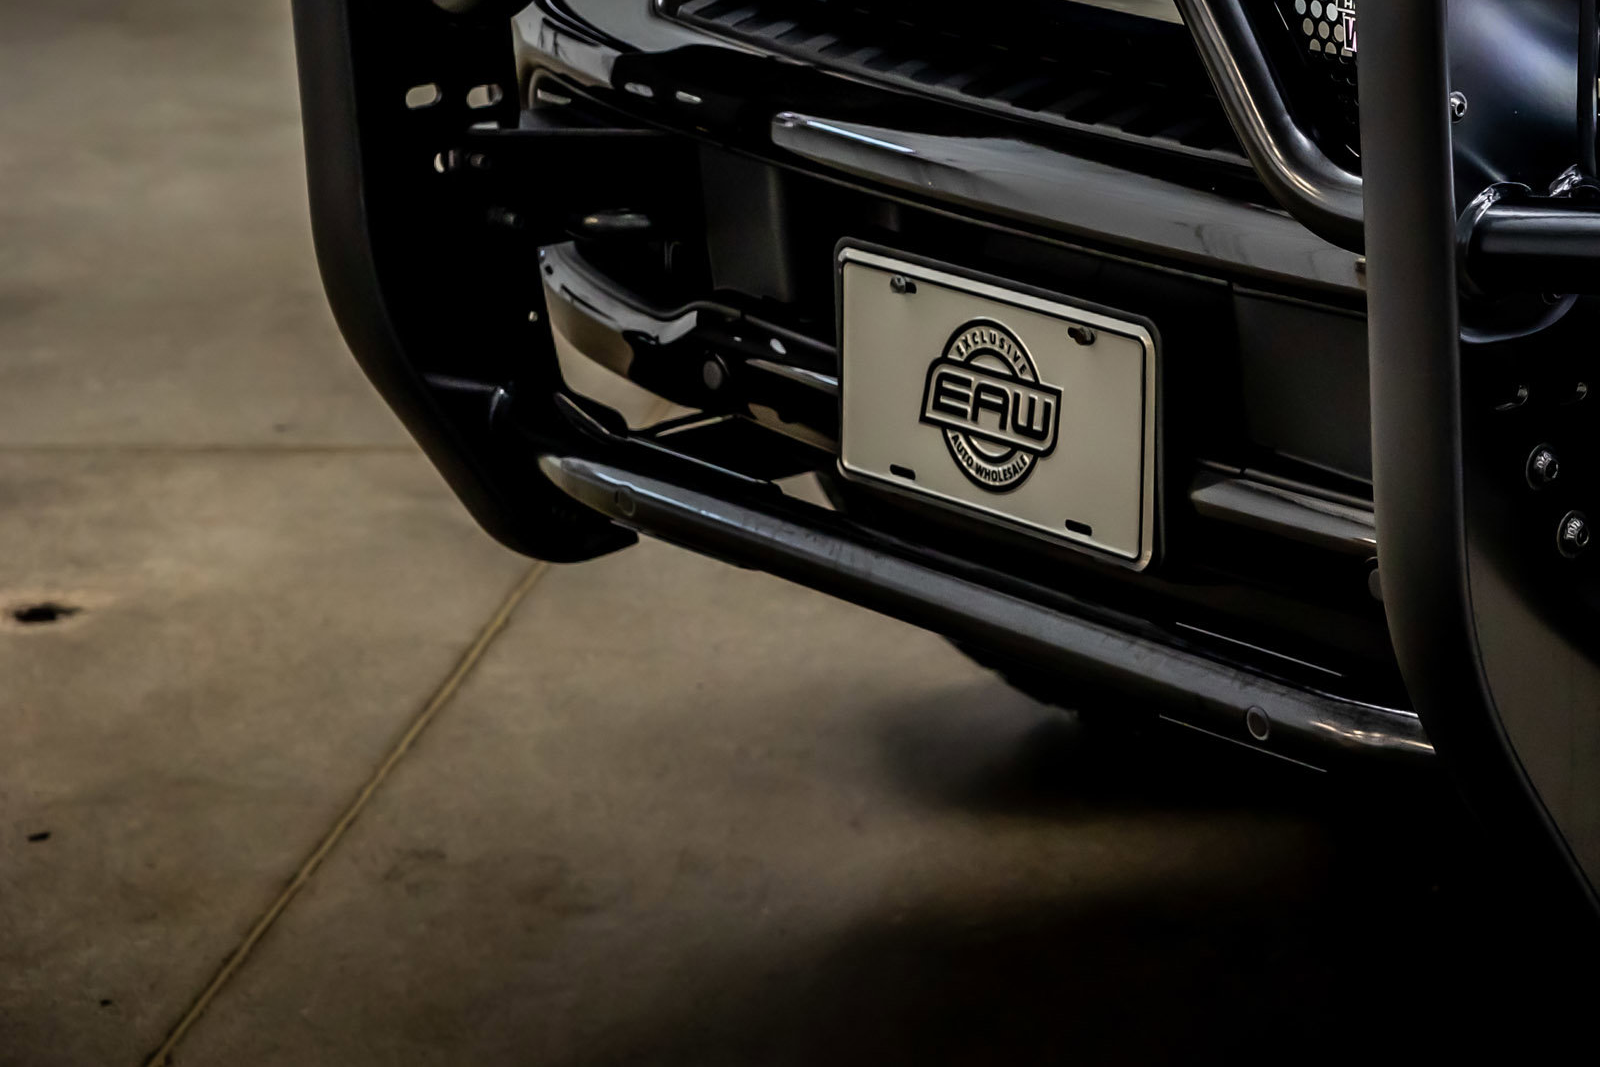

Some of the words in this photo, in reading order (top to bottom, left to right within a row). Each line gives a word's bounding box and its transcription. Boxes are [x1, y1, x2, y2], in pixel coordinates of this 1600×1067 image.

[956, 330, 1027, 375] EXCLUSIVE
[932, 372, 1052, 442] EAW
[951, 433, 974, 467] AUTO
[974, 454, 1028, 482] WHOLESALE
